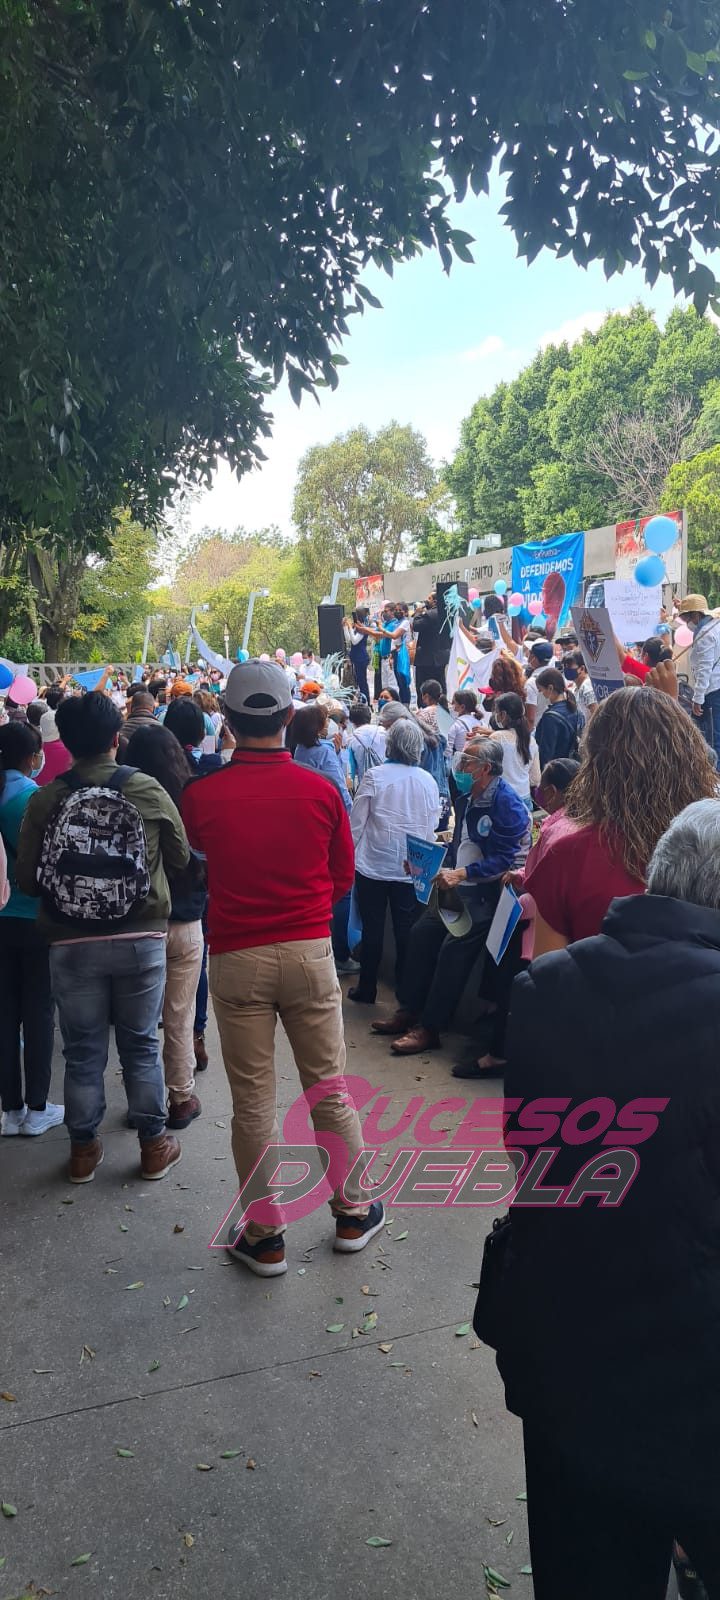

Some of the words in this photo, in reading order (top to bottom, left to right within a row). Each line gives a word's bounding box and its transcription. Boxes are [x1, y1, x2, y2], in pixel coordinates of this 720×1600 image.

[431, 570, 460, 588] PARQUE
[464, 565, 493, 582] ENITO
[520, 557, 574, 579] DEFENDEMOS
[522, 579, 530, 593] LA
